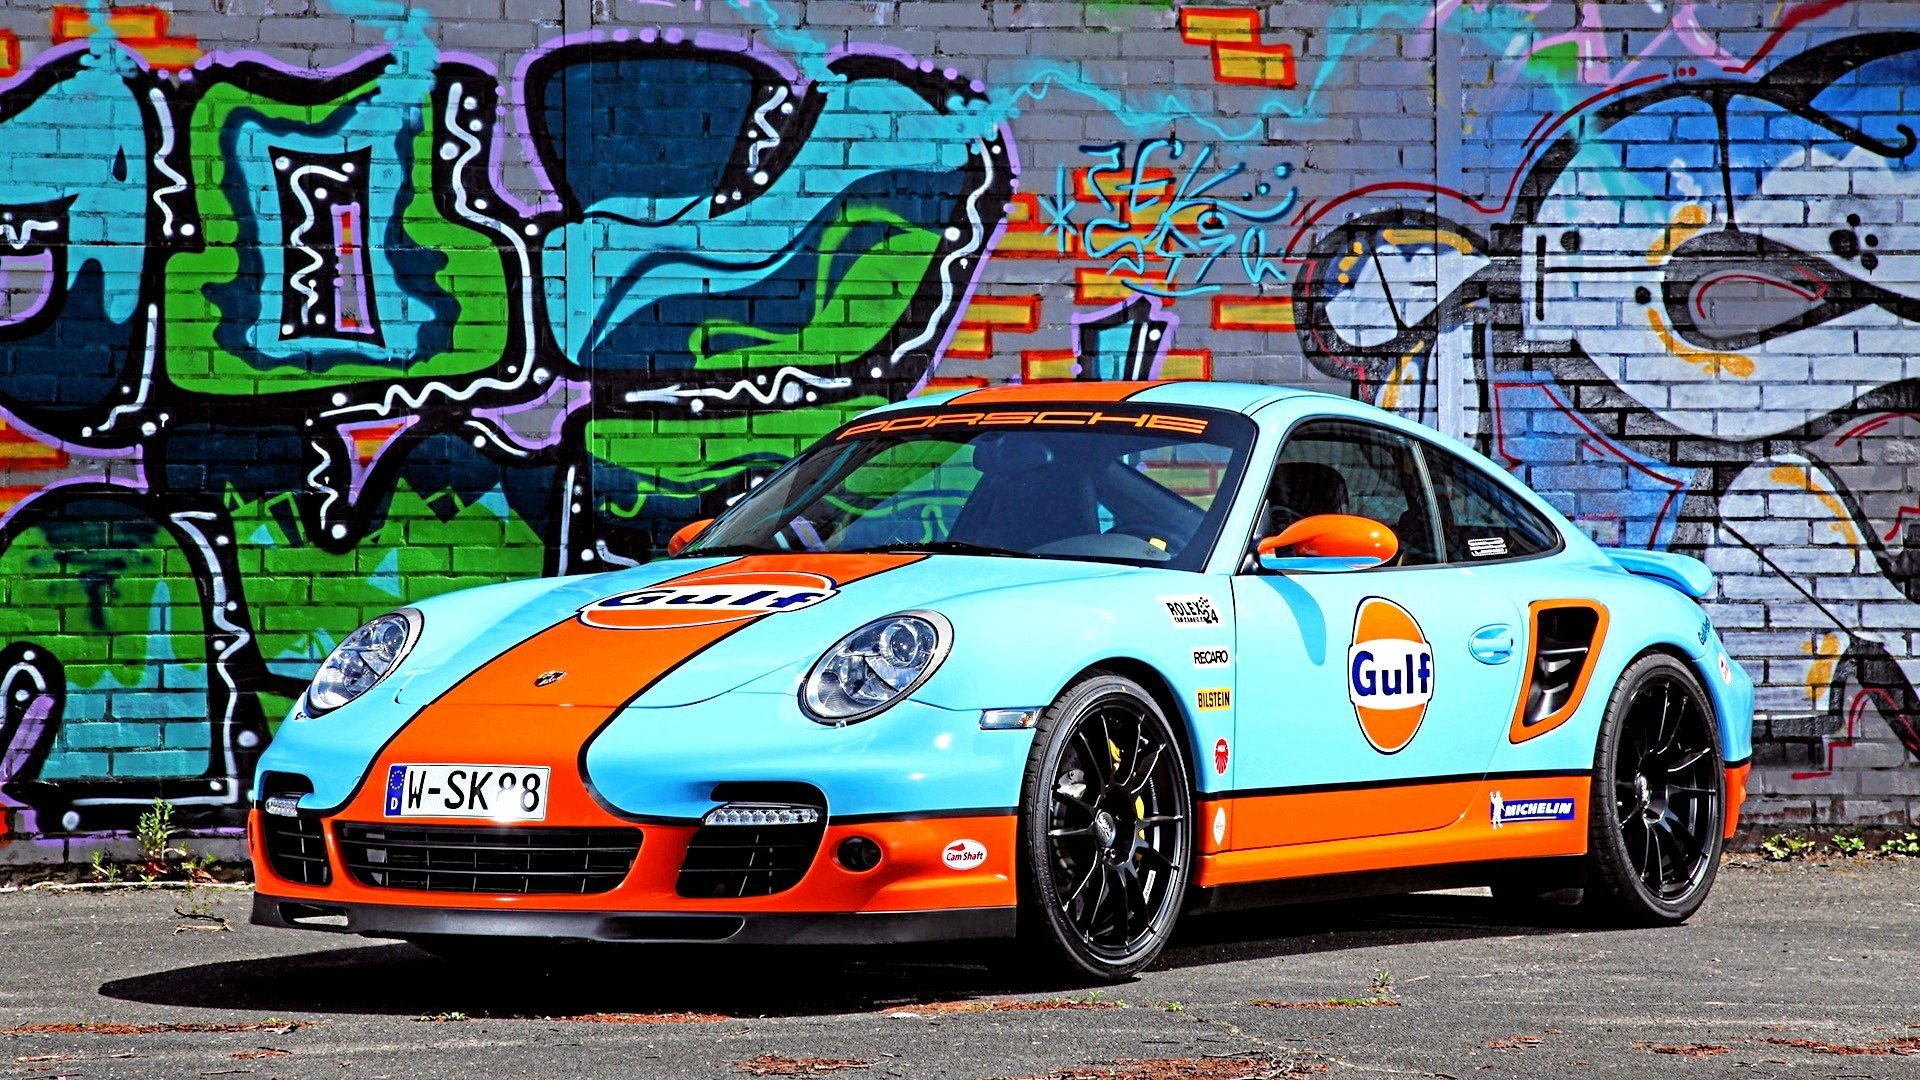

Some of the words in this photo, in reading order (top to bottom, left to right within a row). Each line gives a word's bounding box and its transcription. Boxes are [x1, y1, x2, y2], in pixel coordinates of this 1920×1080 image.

[836, 411, 1208, 440] PORSCHE
[598, 590, 826, 608] Gulf
[1166, 602, 1205, 616] ROLEX
[1203, 609, 1218, 624] 24
[1193, 650, 1228, 664] RECARO
[1352, 650, 1430, 696] Gulf
[1198, 691, 1230, 707] BILSTEIN
[390, 797, 398, 810] D
[1504, 802, 1573, 817] MICHELIN
[946, 852, 962, 861] Cam
[963, 851, 984, 860] Shaft
